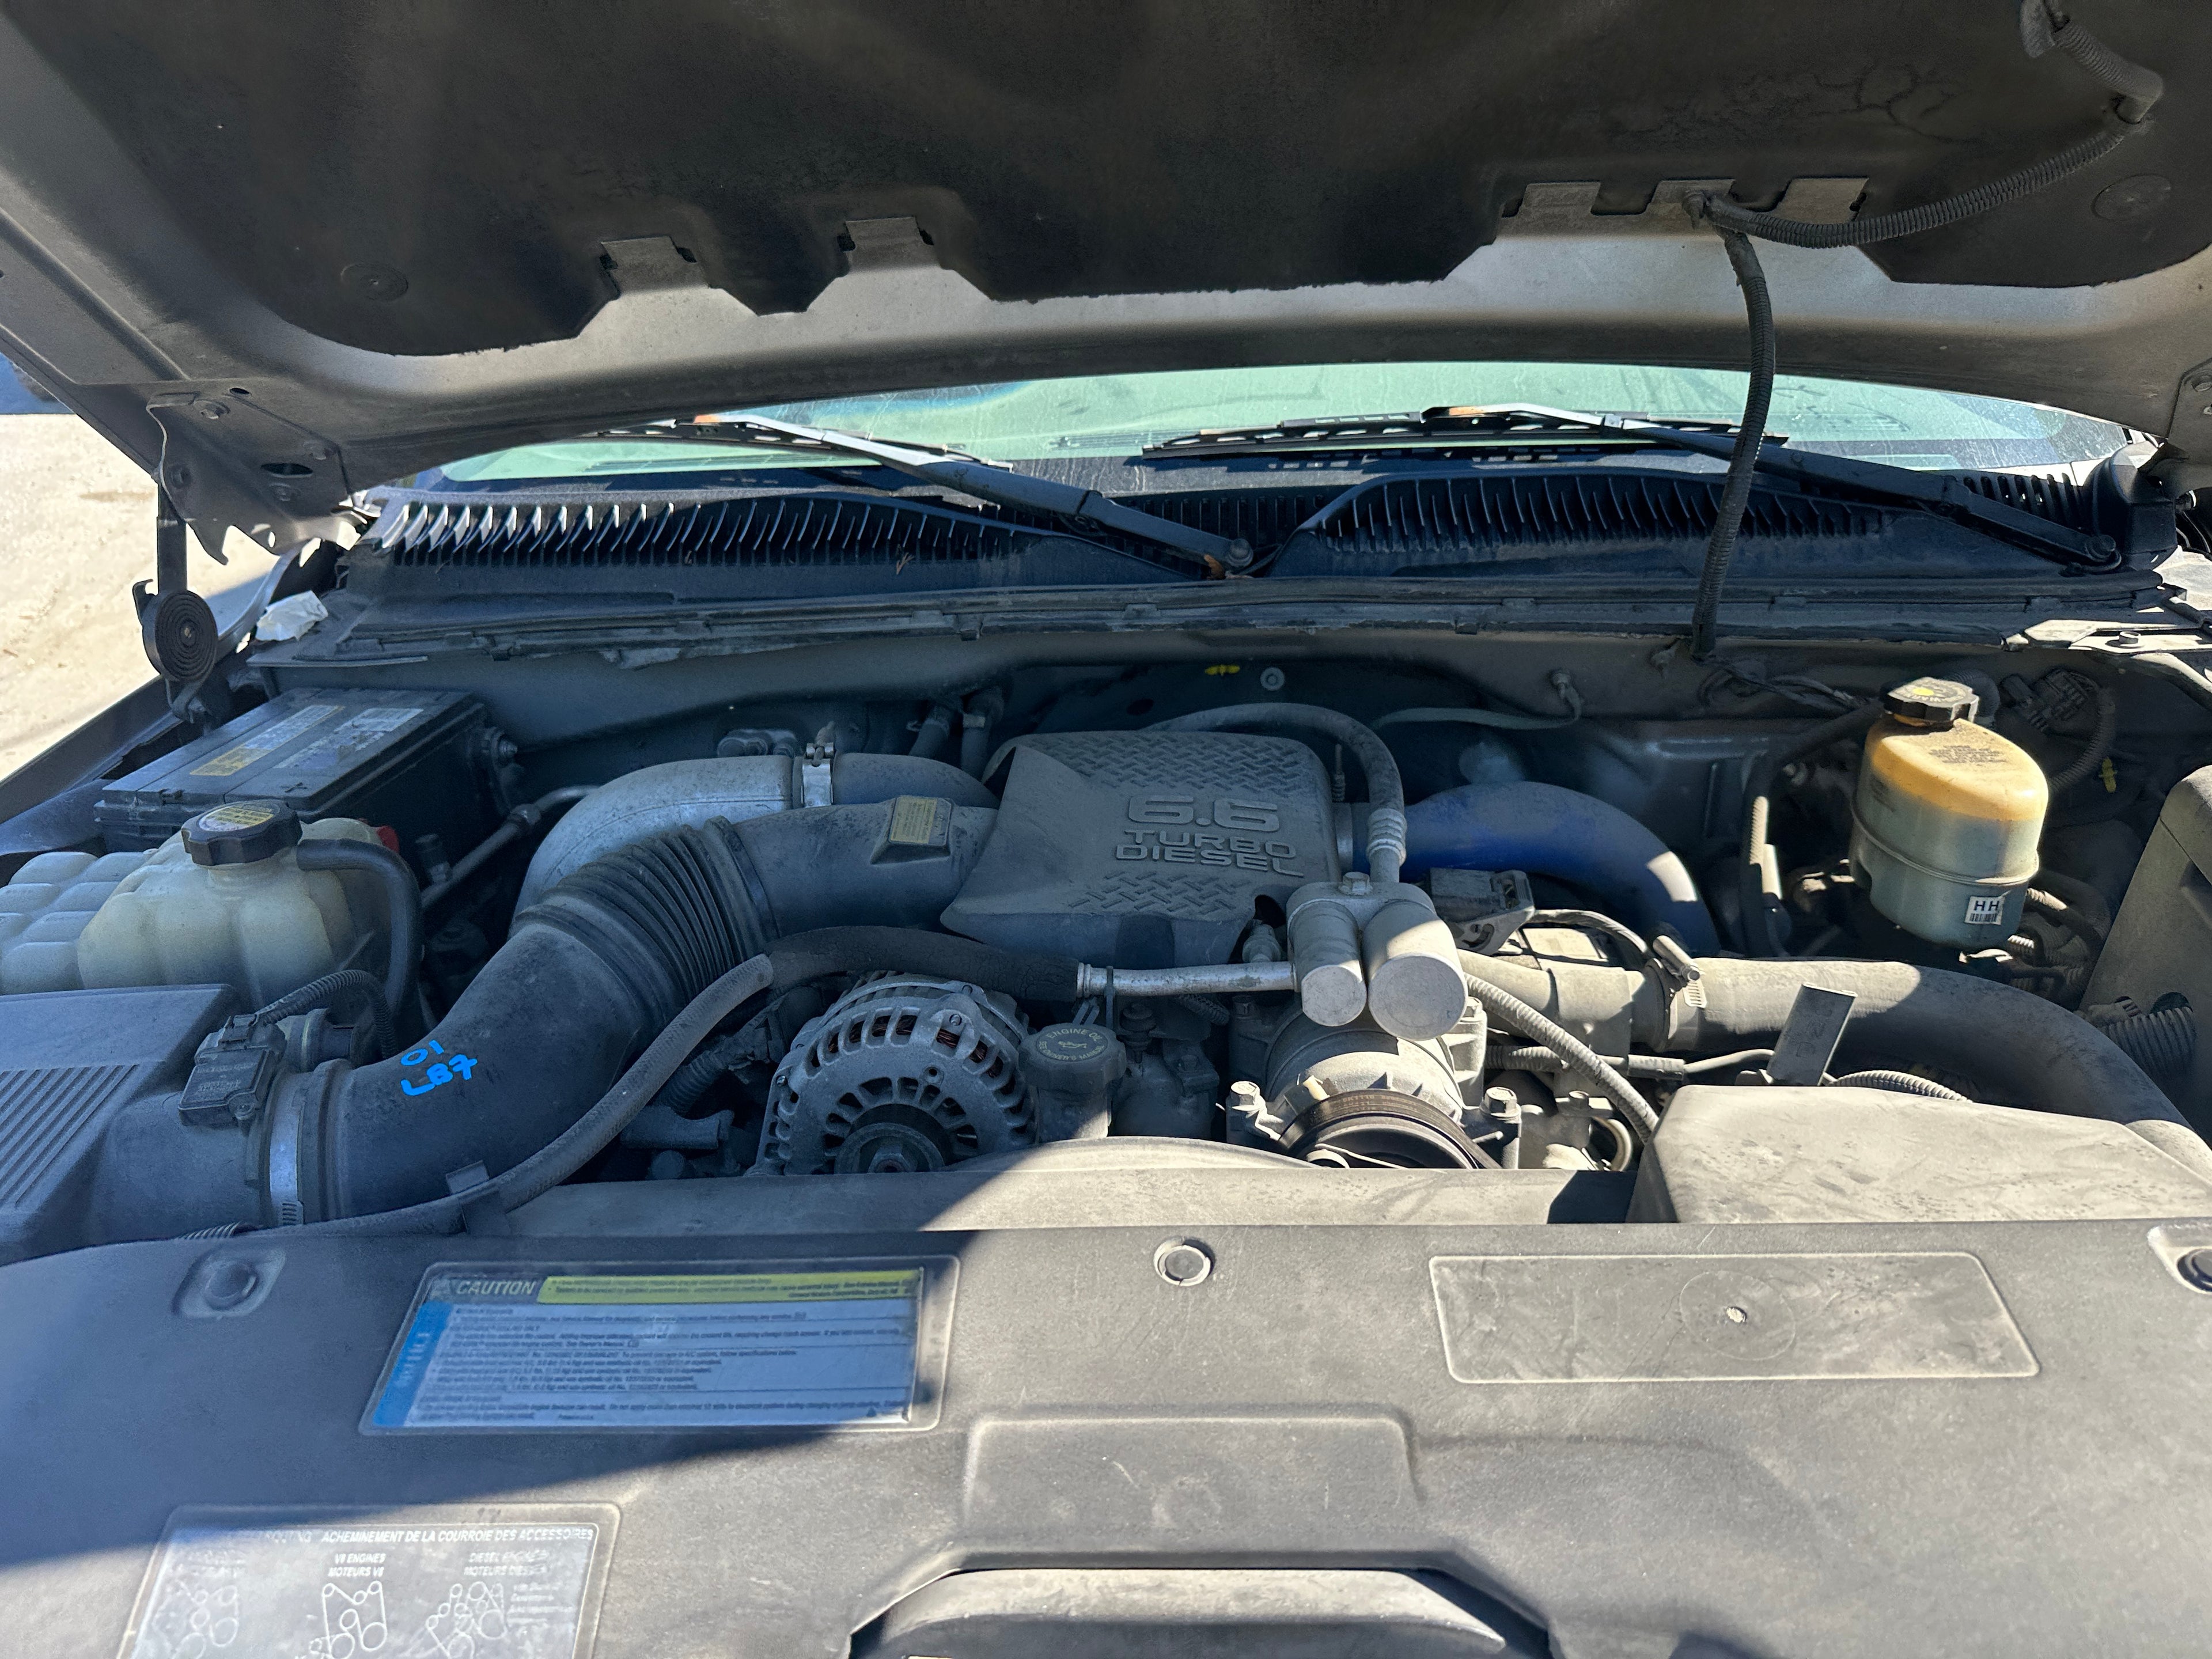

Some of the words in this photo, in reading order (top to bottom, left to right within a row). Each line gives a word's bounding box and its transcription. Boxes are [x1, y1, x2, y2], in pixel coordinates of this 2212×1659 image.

[1127, 794, 1280, 833] 6.6
[1124, 828, 1297, 859] TURBO
[1116, 844, 1304, 878] DIESEL
[1046, 1028, 1089, 1039] ENGINE
[1088, 1032, 1103, 1041] OIL
[400, 1040, 444, 1066] 01
[400, 1054, 478, 1096] LB7
[457, 1279, 537, 1295] CAUTION
[321, 1530, 404, 1543] ACHEMINEMENT
[405, 1530, 421, 1542] DE
[421, 1530, 435, 1542] LA
[438, 1529, 494, 1542] COURROIE
[494, 1529, 517, 1541] DES
[347, 1553, 387, 1563] ENGINES
[469, 1552, 500, 1563] DIESEL
[328, 1567, 372, 1577] MOTEURS
[464, 1566, 507, 1576] MOTEURS
